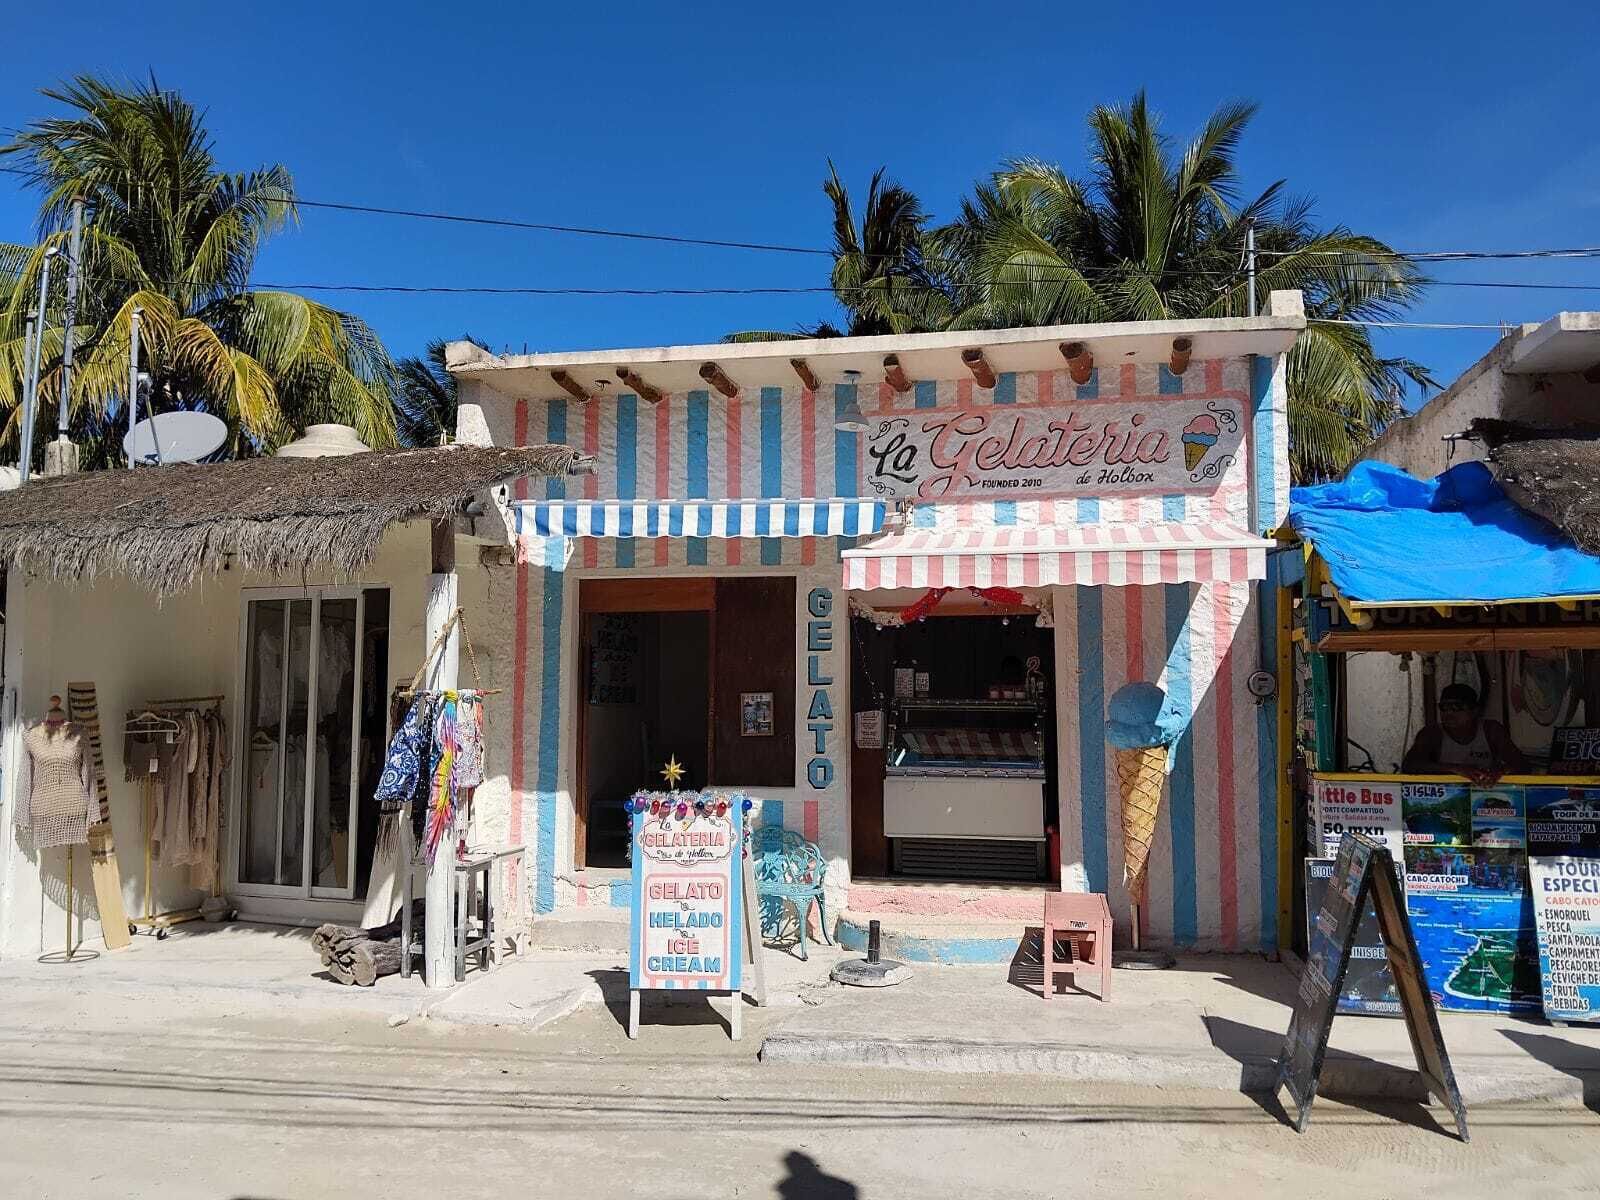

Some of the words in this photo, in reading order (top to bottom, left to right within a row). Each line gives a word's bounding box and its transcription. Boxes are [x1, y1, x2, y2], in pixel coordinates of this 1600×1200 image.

[869, 433, 919, 483] La
[917, 412, 1169, 498] Gelateria
[1076, 470, 1091, 485] de
[1097, 465, 1154, 485] Holbox
[982, 479, 1019, 488] FOUNDED
[1022, 479, 1042, 487] 2010
[807, 587, 833, 789] GELATO
[1360, 788, 1393, 805] Bus
[1403, 786, 1410, 797] 3
[1413, 786, 1445, 798] ISLAS
[1323, 823, 1344, 835] 50
[1348, 826, 1384, 836] mxn
[645, 832, 724, 847] GELATERIA
[1430, 876, 1466, 884] CATOCHE
[650, 882, 723, 899] GELATO
[1545, 897, 1571, 905] CABO
[649, 912, 723, 928] HELADO
[1545, 909, 1591, 921] ESNORQUEL
[1546, 922, 1572, 933] PESCA
[1548, 935, 1573, 944] SANTA
[667, 939, 700, 954] ICE
[648, 956, 721, 973] CREAM
[1552, 973, 1586, 984] CEVICHE
[1553, 985, 1578, 996] FRUTA
[1554, 998, 1588, 1009] BEBIDAS
